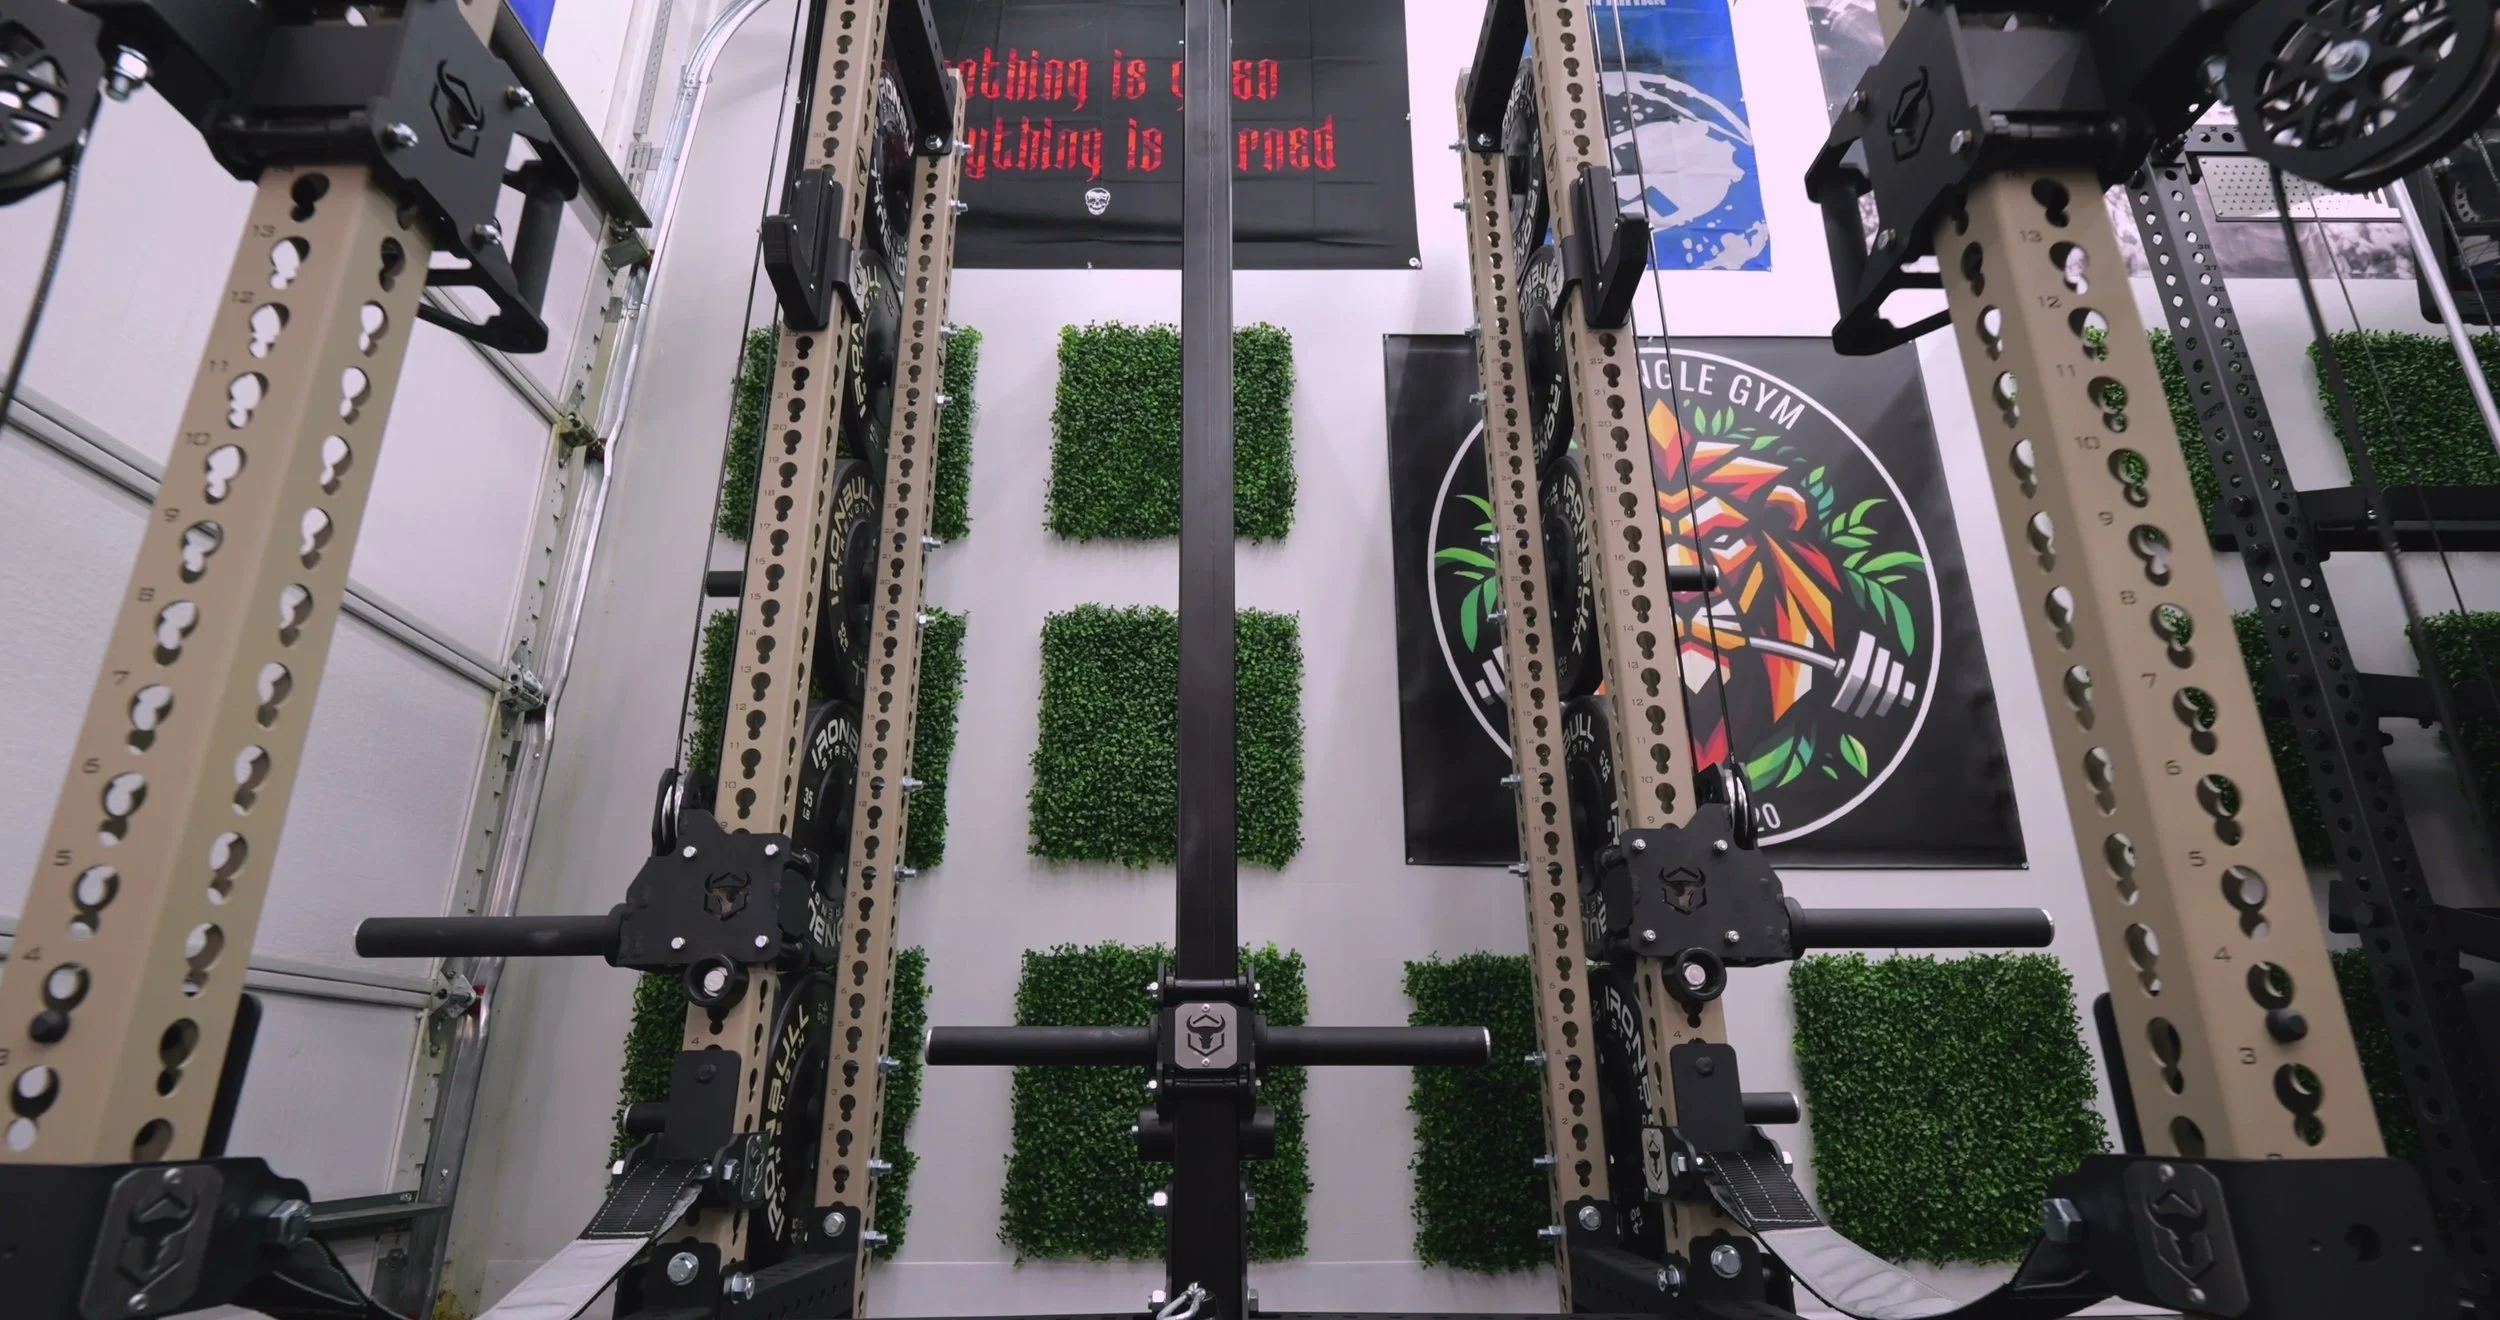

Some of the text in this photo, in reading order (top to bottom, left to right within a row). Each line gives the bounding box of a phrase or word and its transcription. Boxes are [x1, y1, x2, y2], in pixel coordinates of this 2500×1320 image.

[944, 47, 1089, 113] othing
[1112, 49, 1148, 100] is
[964, 115, 1103, 182] ything
[1127, 117, 1163, 172] is
[1237, 114, 1337, 172] rned
[2019, 228, 2043, 243] 13
[2038, 295, 2062, 310] 12
[1589, 357, 1604, 365] 22
[2055, 364, 2077, 378] 11
[1640, 358, 1806, 431] NGLE GYM
[1597, 420, 1612, 428] 20
[185, 431, 211, 446] 10
[2074, 435, 2101, 451] 10
[769, 456, 780, 464] 19
[1601, 452, 1613, 460] 19
[764, 489, 776, 497] 18
[1605, 485, 1617, 493] 18
[164, 508, 180, 523] 9
[2097, 510, 2115, 526] 9
[760, 522, 771, 530] 17
[1610, 519, 1621, 527] 17
[829, 475, 876, 606] IRONBULL
[1563, 473, 1591, 656] IRONBULL
[137, 586, 155, 602] 8
[750, 592, 762, 600] 15
[1618, 589, 1630, 597] 15
[2119, 590, 2138, 606] 8
[1623, 624, 1634, 632] 14
[740, 665, 752, 673] 13
[1628, 661, 1639, 669] 13
[112, 669, 131, 686] 7
[2140, 672, 2158, 689] 7
[1632, 698, 1643, 706] 12
[735, 703, 747, 711] 12
[811, 717, 859, 769] IRONB
[1636, 736, 1647, 745] 11
[729, 741, 740, 750] 11
[81, 757, 101, 774] 6
[2164, 759, 2183, 776] 6
[1641, 775, 1653, 784] 10
[724, 780, 737, 789] 10
[1646, 815, 1655, 824] 9
[720, 821, 728, 829] 9
[52, 849, 72, 867] 5
[1536, 855, 1546, 863] 10
[2187, 850, 2208, 868] 5
[20, 946, 42, 962] 4
[2214, 945, 2233, 964] 4
[1549, 981, 1556, 989] 6
[1552, 1014, 1559, 1023] 5
[1673, 1030, 1682, 1038] 4
[691, 1036, 699, 1045] 4
[2238, 1046, 2258, 1065] 3
[1561, 1117, 1569, 1125] 2
